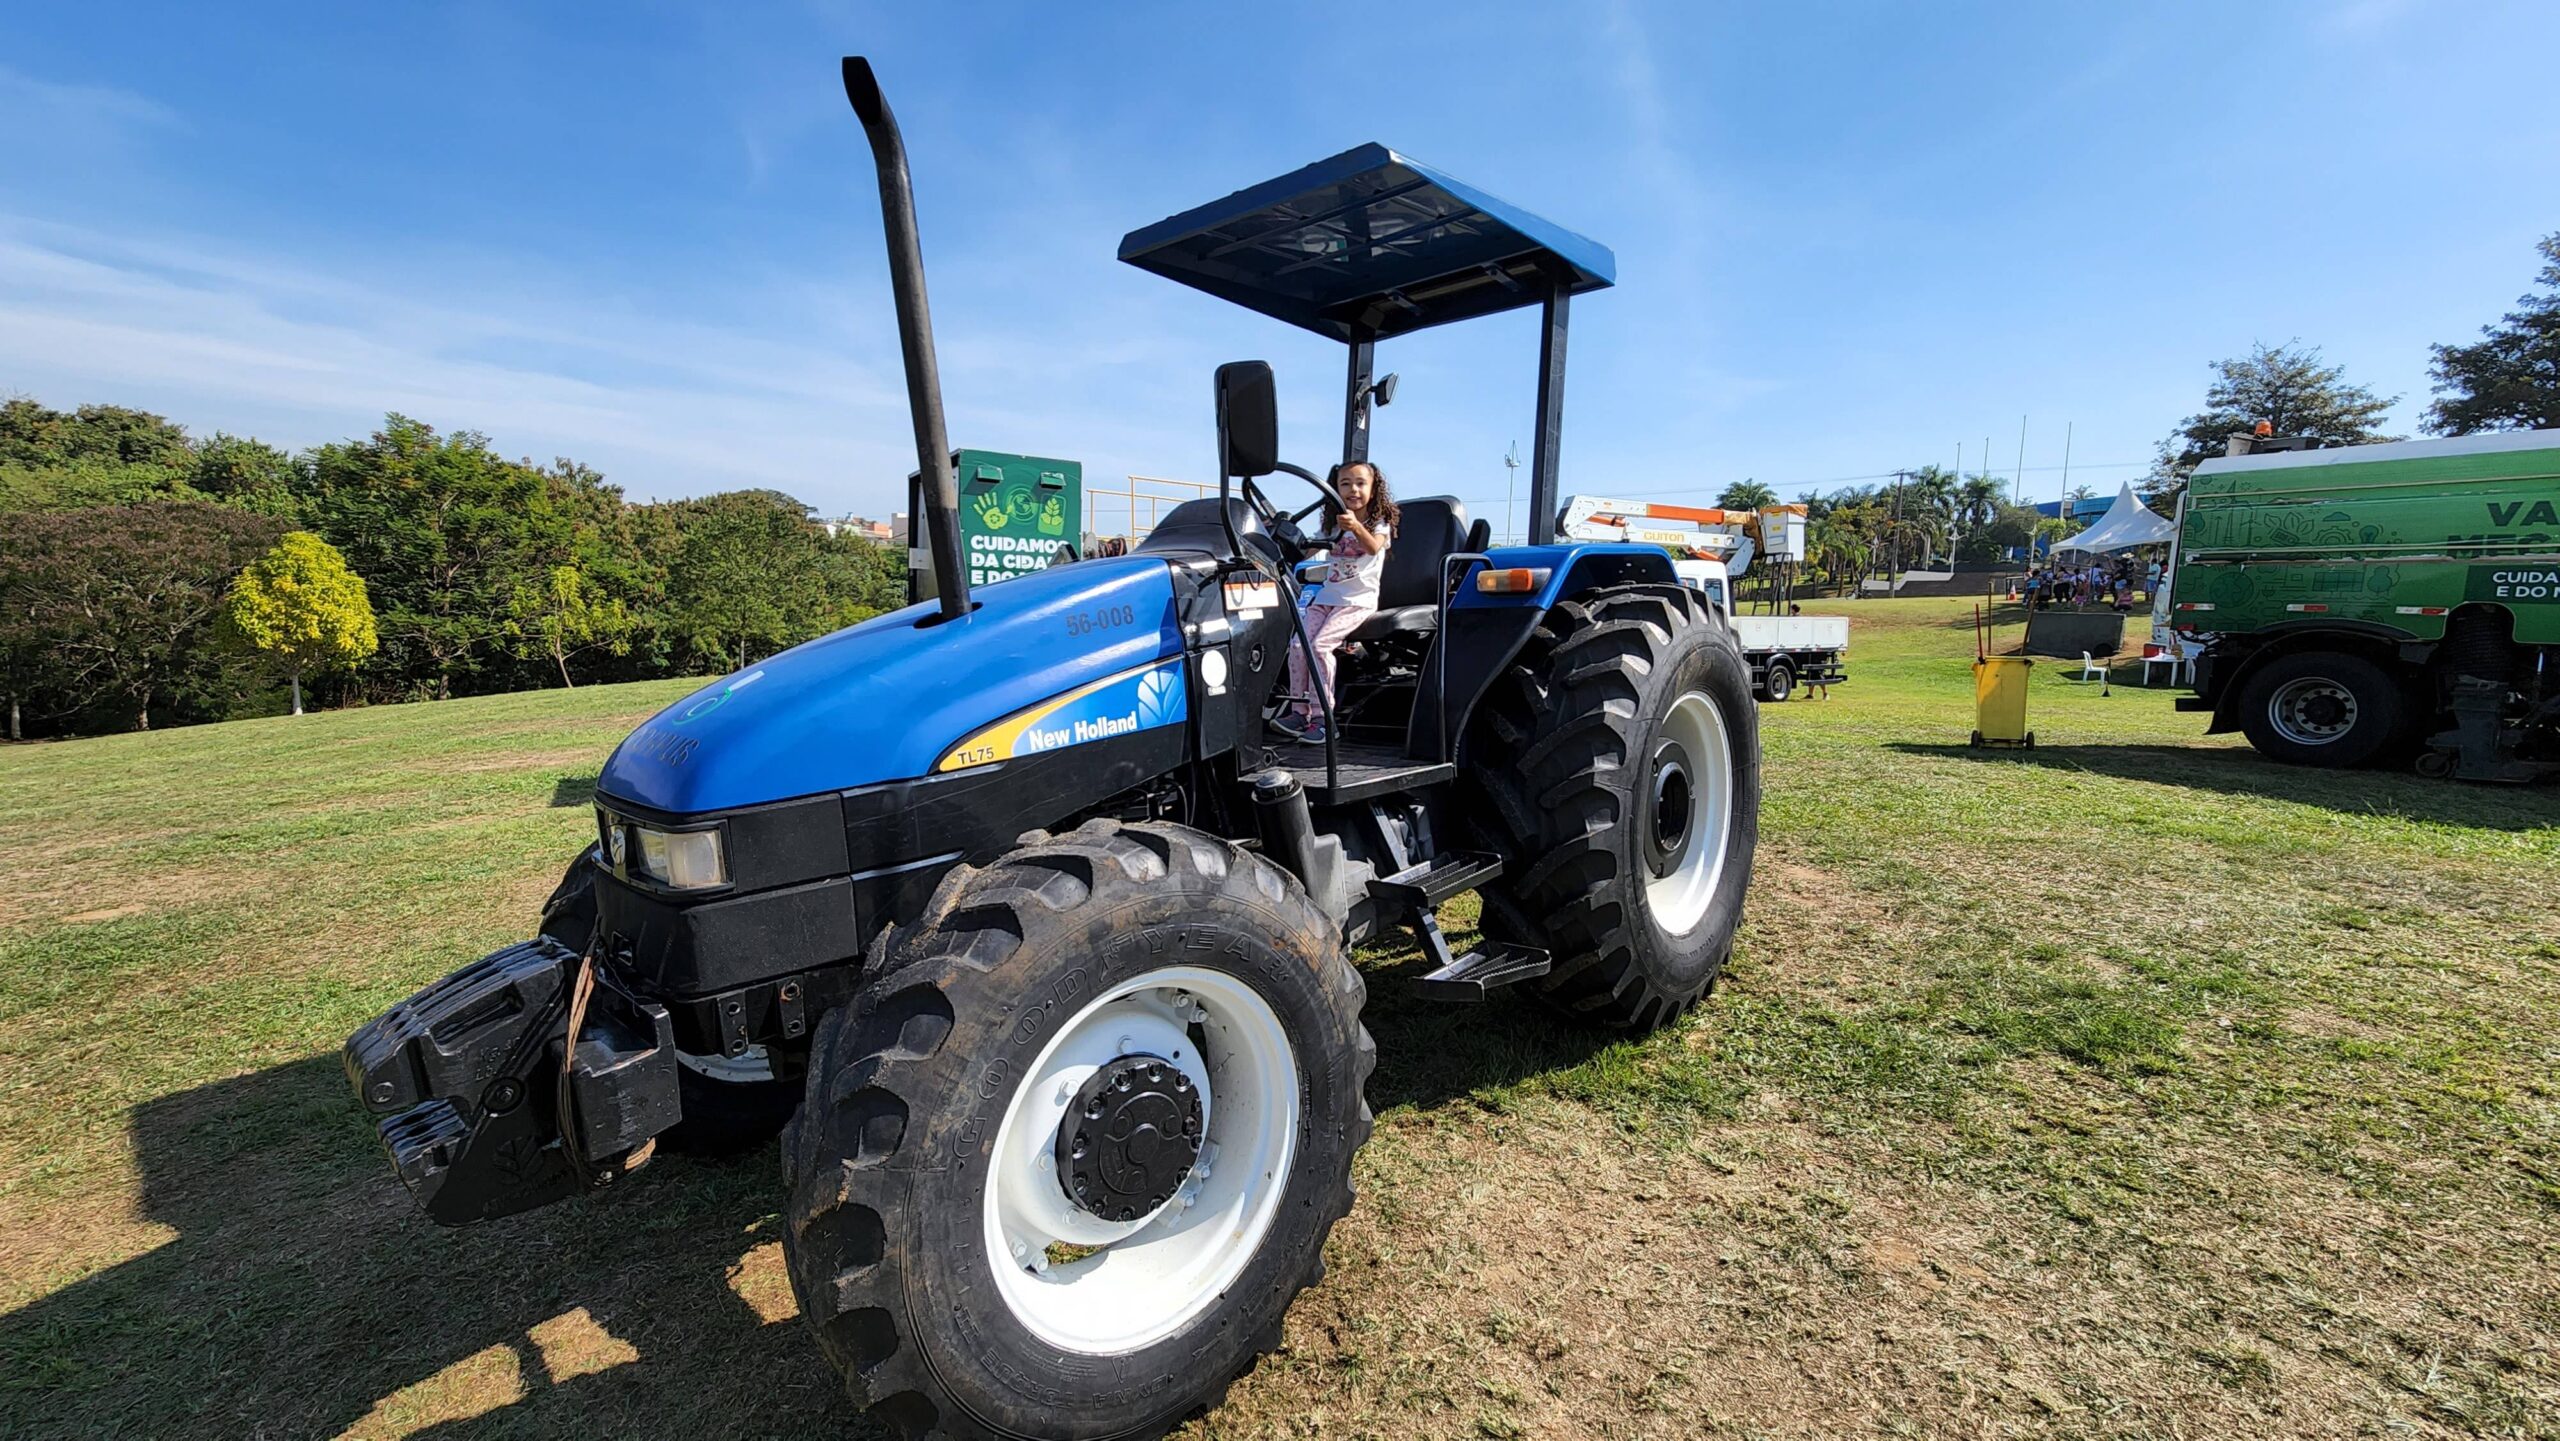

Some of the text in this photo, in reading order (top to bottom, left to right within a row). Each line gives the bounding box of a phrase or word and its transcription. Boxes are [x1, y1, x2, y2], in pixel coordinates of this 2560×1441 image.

[971, 553, 999, 568] DA
[971, 570, 984, 584] E
[2496, 586, 2508, 597] E
[2515, 586, 2547, 598] DO
[1066, 604, 1134, 637] 56-008
[1028, 711, 1138, 752] New Holland
[957, 746, 995, 766] TL75
[952, 922, 1292, 1158] GOODYEAR
